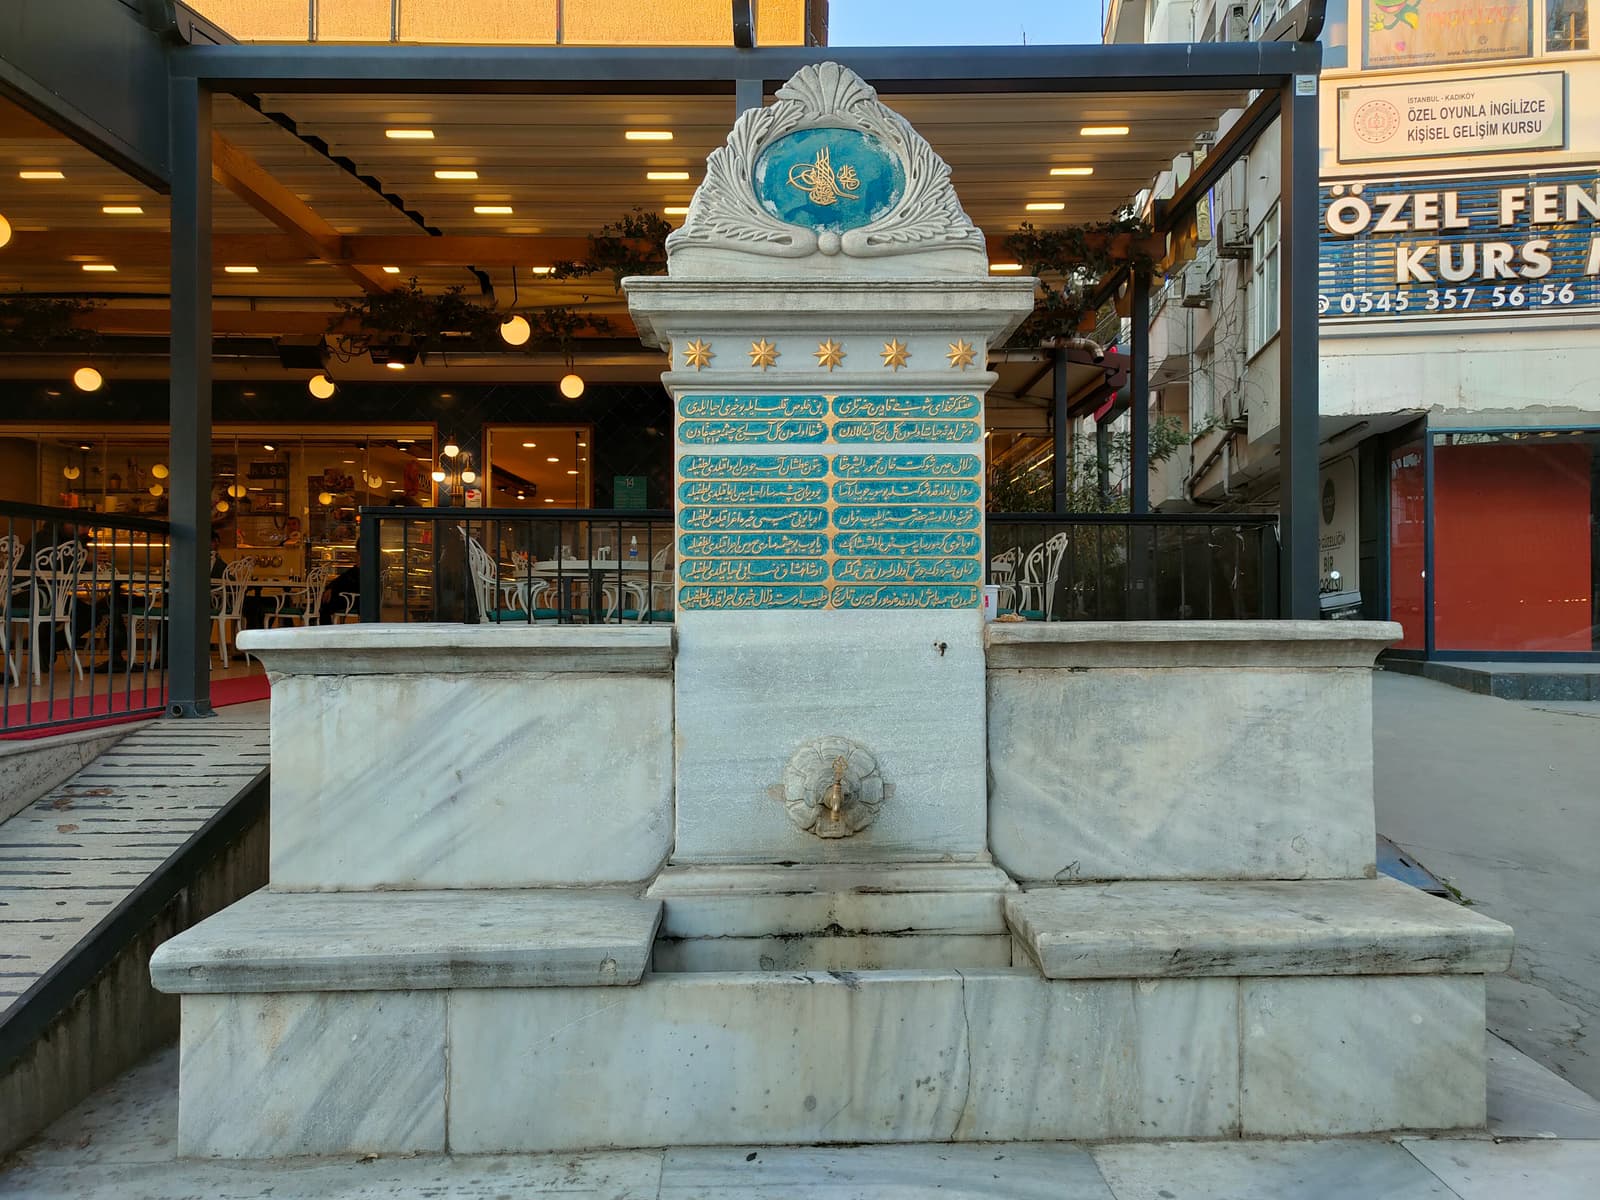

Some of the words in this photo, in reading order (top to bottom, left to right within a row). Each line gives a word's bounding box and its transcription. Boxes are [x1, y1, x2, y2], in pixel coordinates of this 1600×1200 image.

[1407, 95, 1440, 104] İSTANBUL
[1445, 92, 1476, 102] KADIKÖY
[1407, 106, 1437, 122] ÖZEL
[1439, 103, 1487, 120] OYUNLA
[1490, 98, 1546, 116] İNGİLİZCE
[1407, 125, 1450, 145] KİŞİSEL
[1453, 121, 1498, 141] GELİŞİM
[1502, 119, 1543, 135] KURSU
[1325, 183, 1470, 236] ÖZEL
[1500, 184, 1600, 226] FEN
[1395, 239, 1553, 284] KURS
[1340, 290, 1409, 313] 0545
[1425, 288, 1476, 310] 357
[1492, 286, 1525, 307] 56
[1541, 283, 1575, 305] 56
